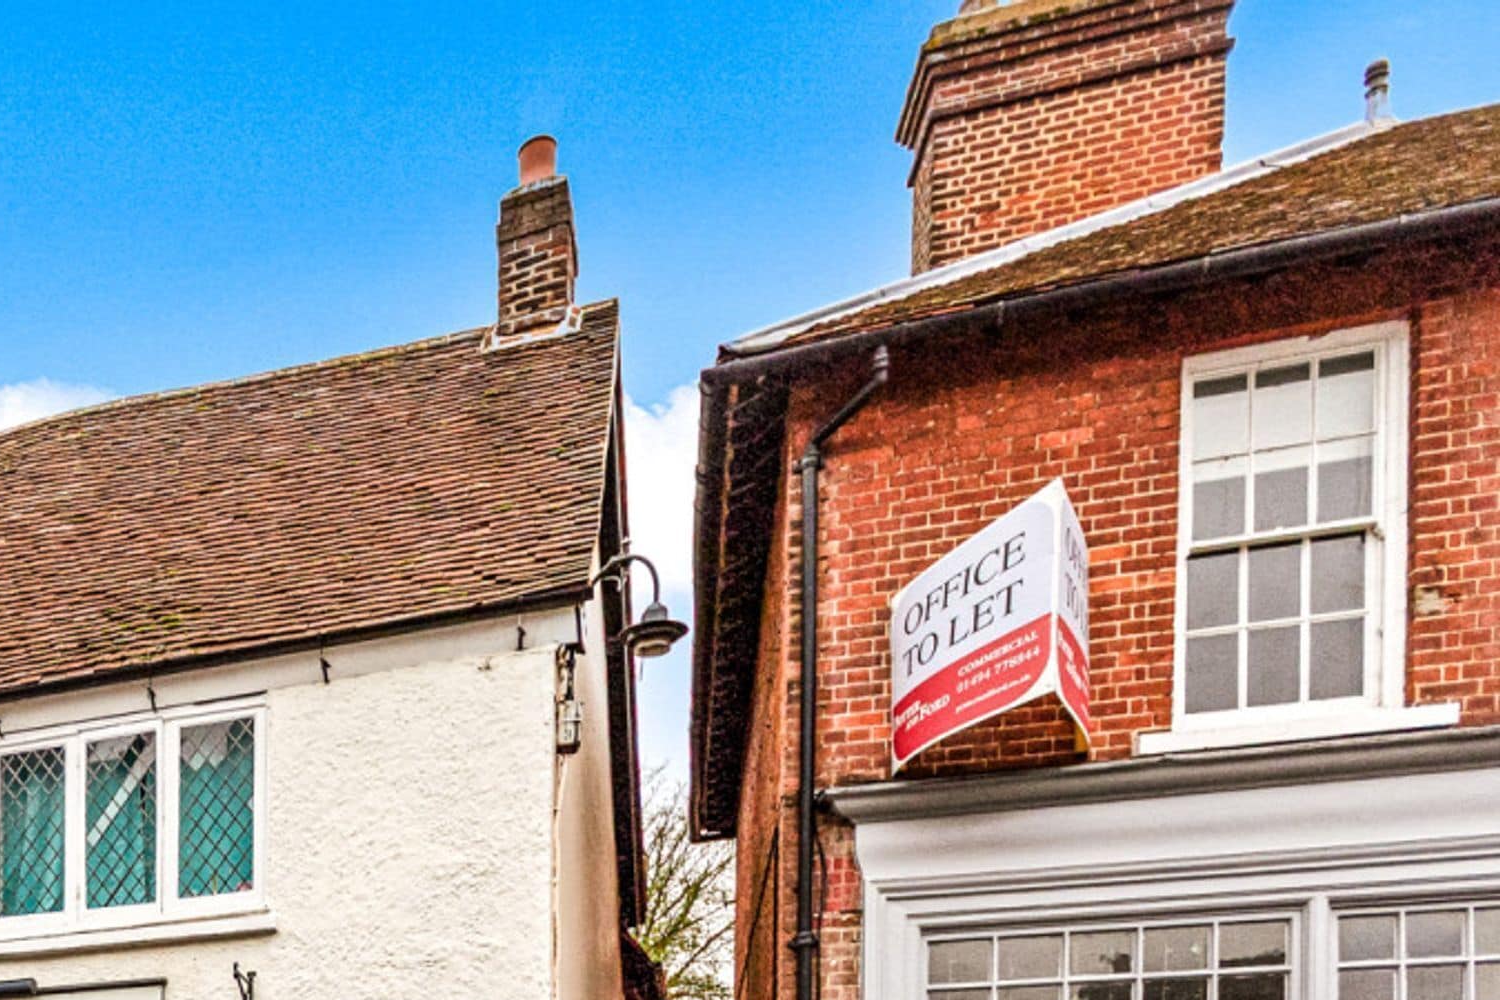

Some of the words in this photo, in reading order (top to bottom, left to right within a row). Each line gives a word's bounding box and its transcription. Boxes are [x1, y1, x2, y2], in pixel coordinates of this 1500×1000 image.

[902, 632, 938, 678] TO
[949, 579, 1025, 650] LET
[903, 531, 1026, 636] OFFICE
[957, 630, 1039, 677] COMMERCIAL
